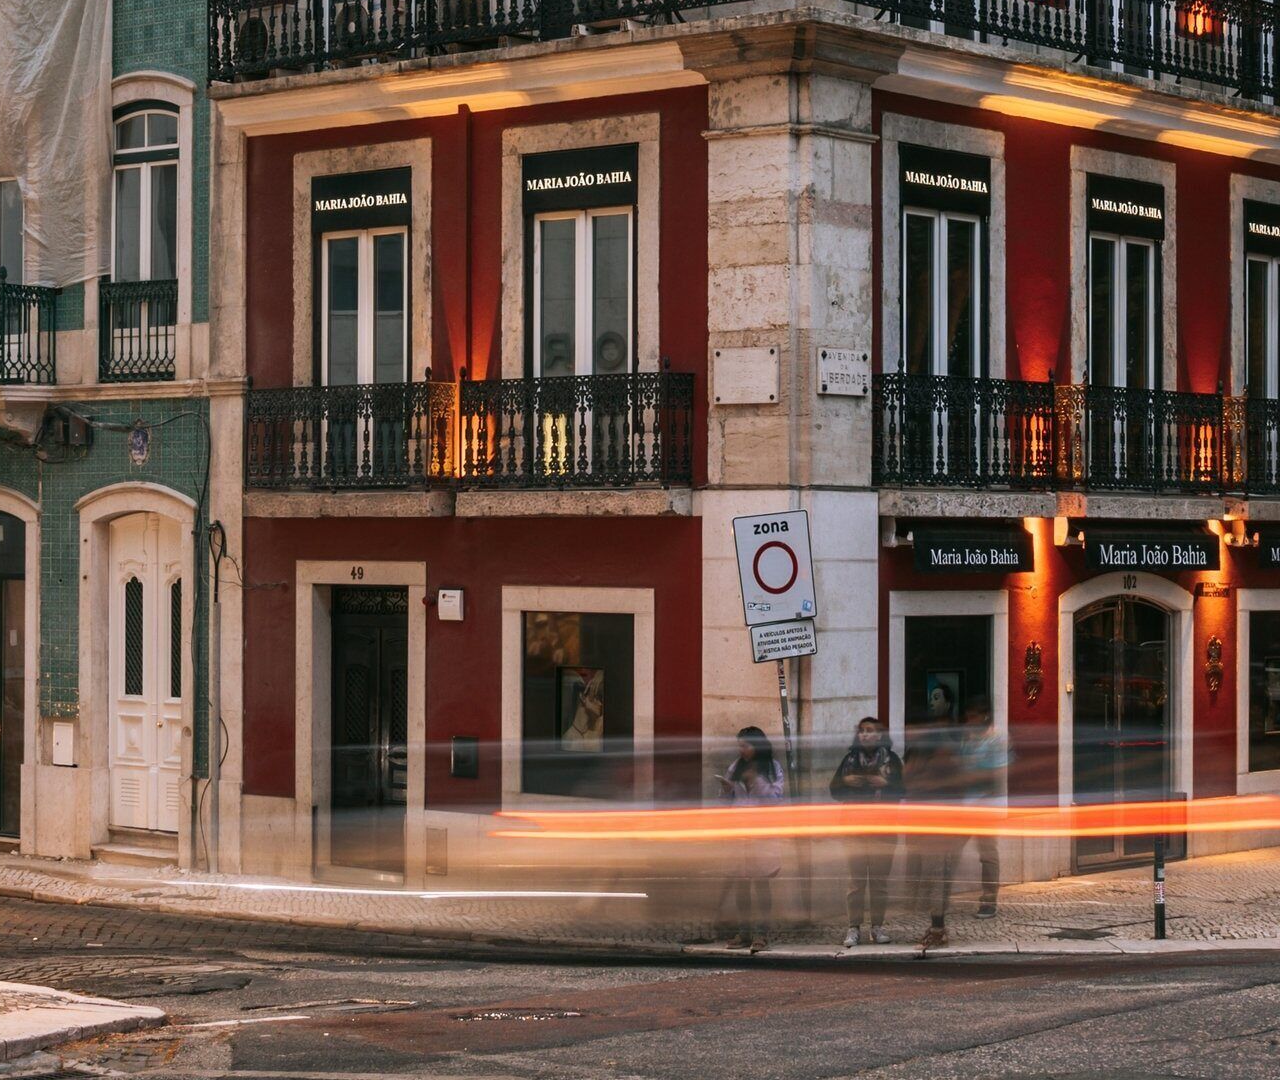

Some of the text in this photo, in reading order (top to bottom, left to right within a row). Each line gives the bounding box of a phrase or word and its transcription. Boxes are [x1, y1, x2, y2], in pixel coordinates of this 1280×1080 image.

[526, 171, 632, 191] MARIA JOÃO BAHIA
[905, 171, 988, 193] MARIA JOÃO BAHIA
[315, 193, 408, 211] MARIA JOÃO BAHIA
[1092, 198, 1163, 220] MARIA JOÃO BAHIA
[1249, 222, 1271, 236] MARIA
[828, 352, 862, 362] AVENIDA
[821, 372, 868, 386] LIBERDADE
[753, 520, 789, 535] zona
[931, 549, 1019, 565] Maria João Bahia
[1100, 544, 1207, 565] Maria João Bahia
[350, 566, 364, 580] 49
[1123, 574, 1137, 590] 102
[787, 633, 812, 642] ANIMAÇÃO
[792, 642, 813, 650] PESADOS
